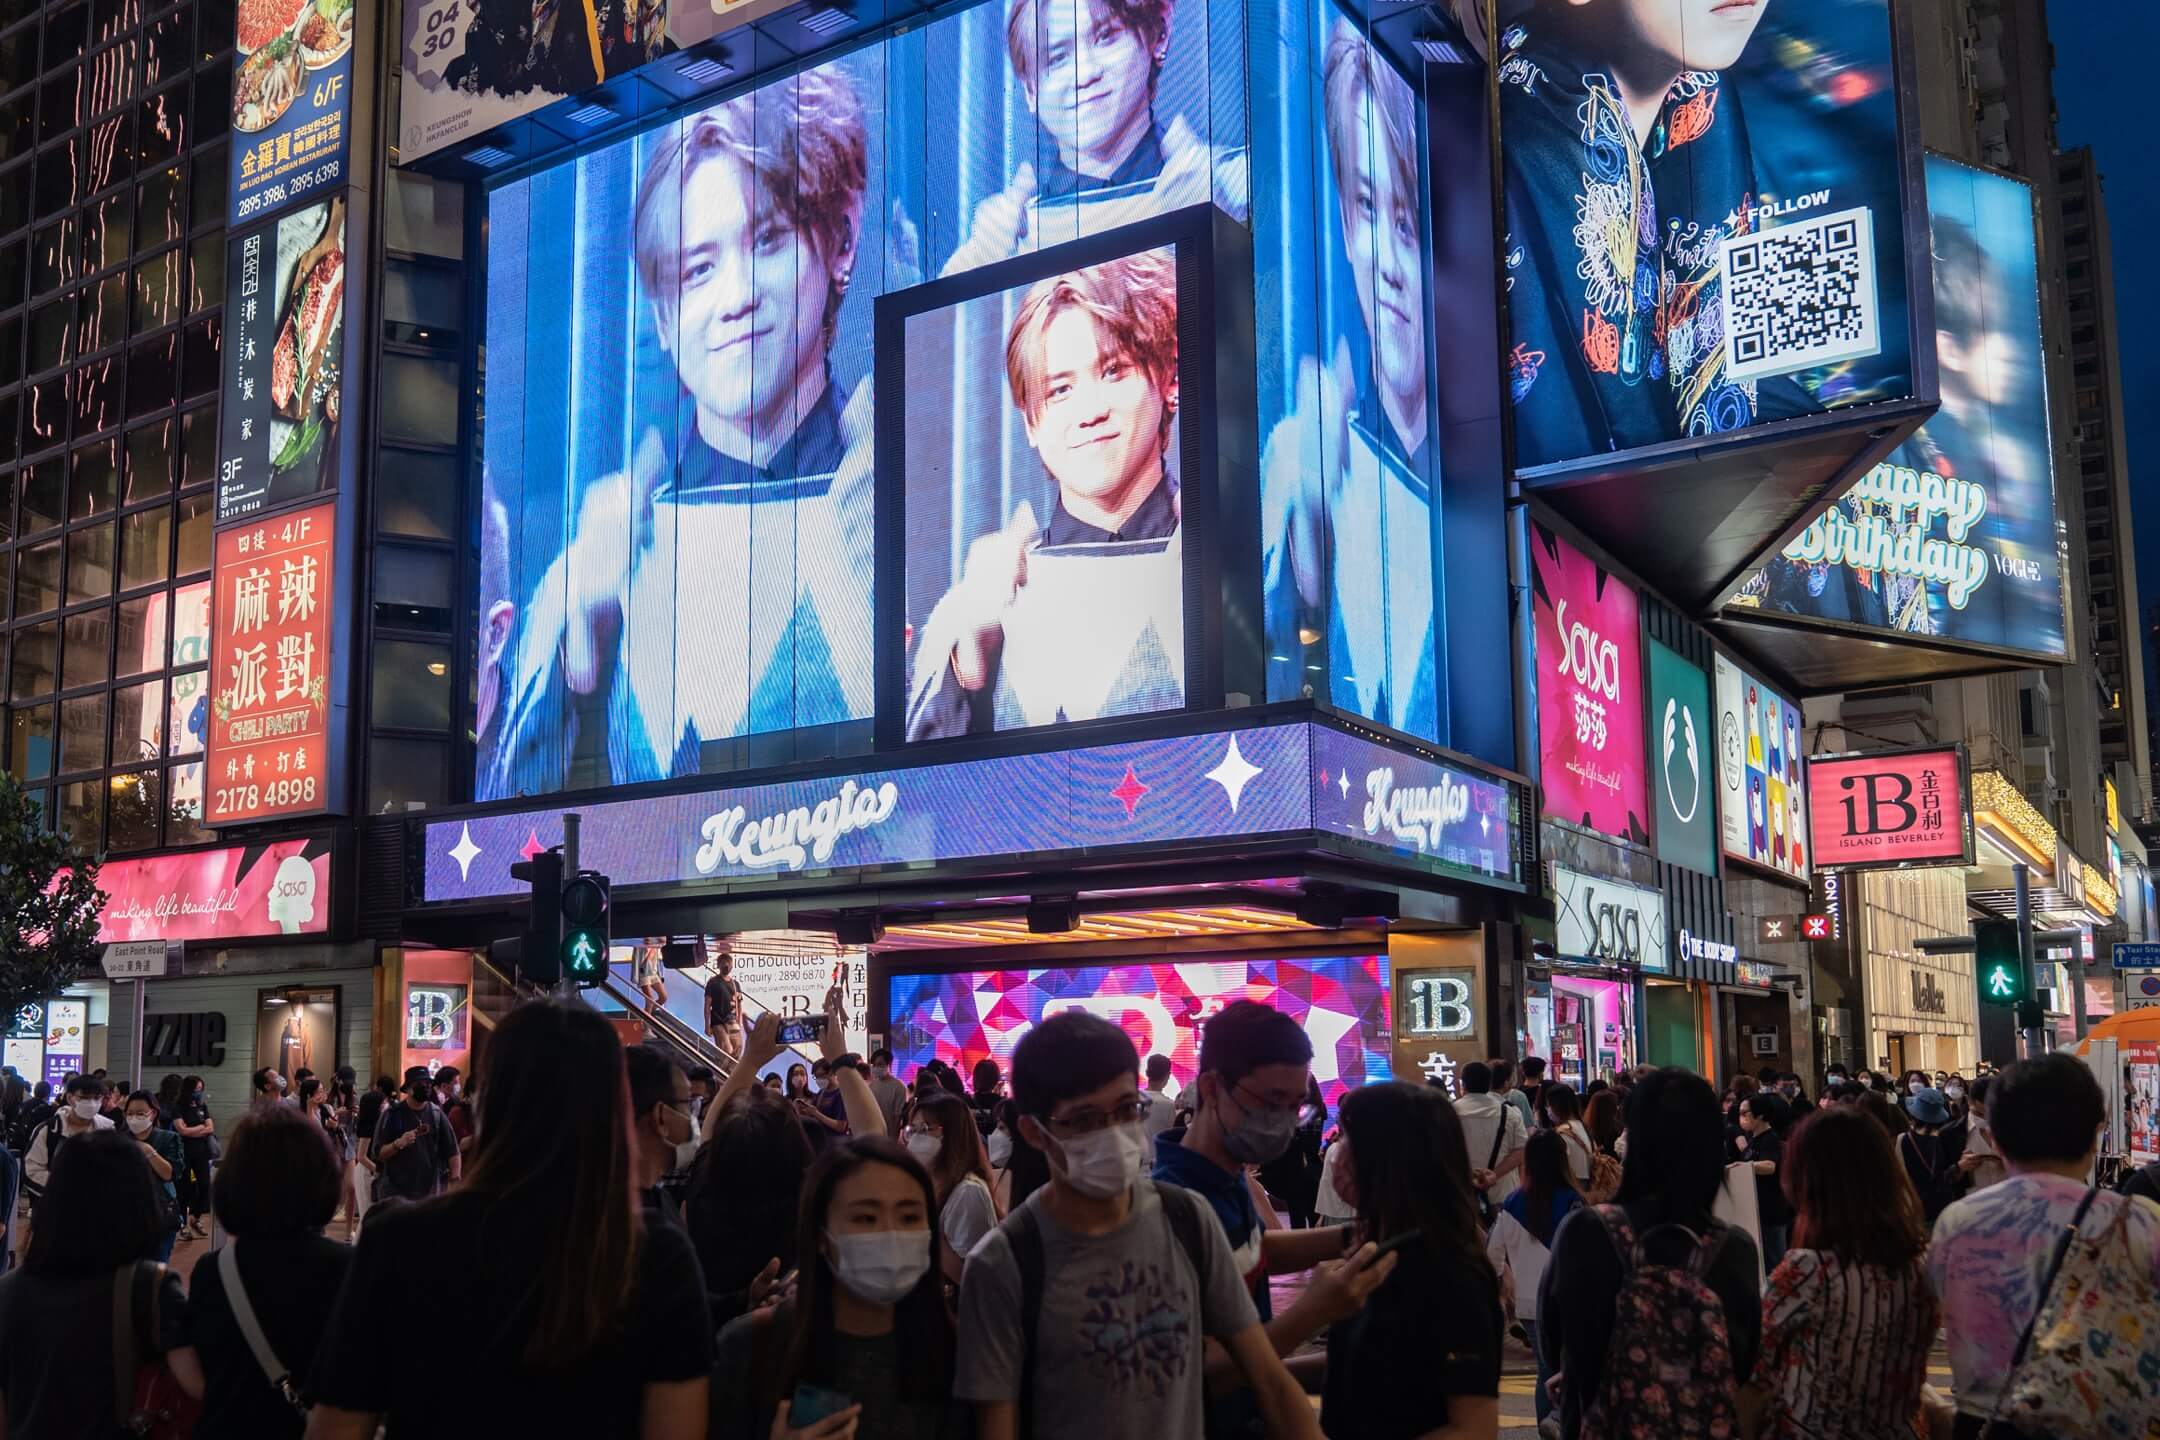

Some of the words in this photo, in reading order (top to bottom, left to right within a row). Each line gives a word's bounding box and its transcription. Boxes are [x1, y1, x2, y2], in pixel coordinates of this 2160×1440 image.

[427, 1, 460, 33] 04
[422, 27, 456, 57] 30
[313, 74, 345, 107] 6/F
[426, 108, 473, 131] KEUNGSHOW
[426, 120, 469, 144] HKFANCLUB
[240, 131, 291, 179] 金羅寶
[238, 191, 261, 217] 2895
[289, 171, 313, 195] 2895
[315, 160, 339, 185] 6398
[1747, 188, 1831, 222] FOLLOW
[222, 457, 243, 481] 3F
[281, 517, 312, 543] 4/F
[1993, 553, 2041, 581] VOGUE
[232, 555, 318, 636] 麻辣
[229, 632, 315, 710] 派對
[229, 717, 264, 743] CHILI
[264, 709, 310, 737] PARTY
[1574, 691, 1607, 751] 莎莎
[276, 746, 307, 774] 訂座
[215, 784, 259, 814] 2178
[264, 776, 316, 807] 4898
[1839, 772, 1917, 836] iB
[1917, 769, 1942, 831] 金百利
[1840, 836, 1882, 848] ISLAND
[1888, 832, 1945, 844] BEVERLEY
[110, 897, 153, 929] making
[154, 892, 180, 928] life
[181, 887, 239, 924] beautiful
[115, 947, 129, 956] East
[129, 946, 146, 956] Point
[147, 945, 164, 954] Road
[758, 953, 826, 971] Boutiques
[1690, 937, 1704, 957] THE
[1704, 940, 1720, 960] BODY
[1720, 943, 1736, 963] SHOP
[739, 972, 772, 984] Enquiry
[778, 970, 800, 981] 2890
[802, 969, 826, 979] 6870
[852, 963, 868, 1032] 金百利
[1410, 978, 1471, 1032] iB
[407, 991, 454, 1040] iB
[1761, 1038, 1768, 1049] E
